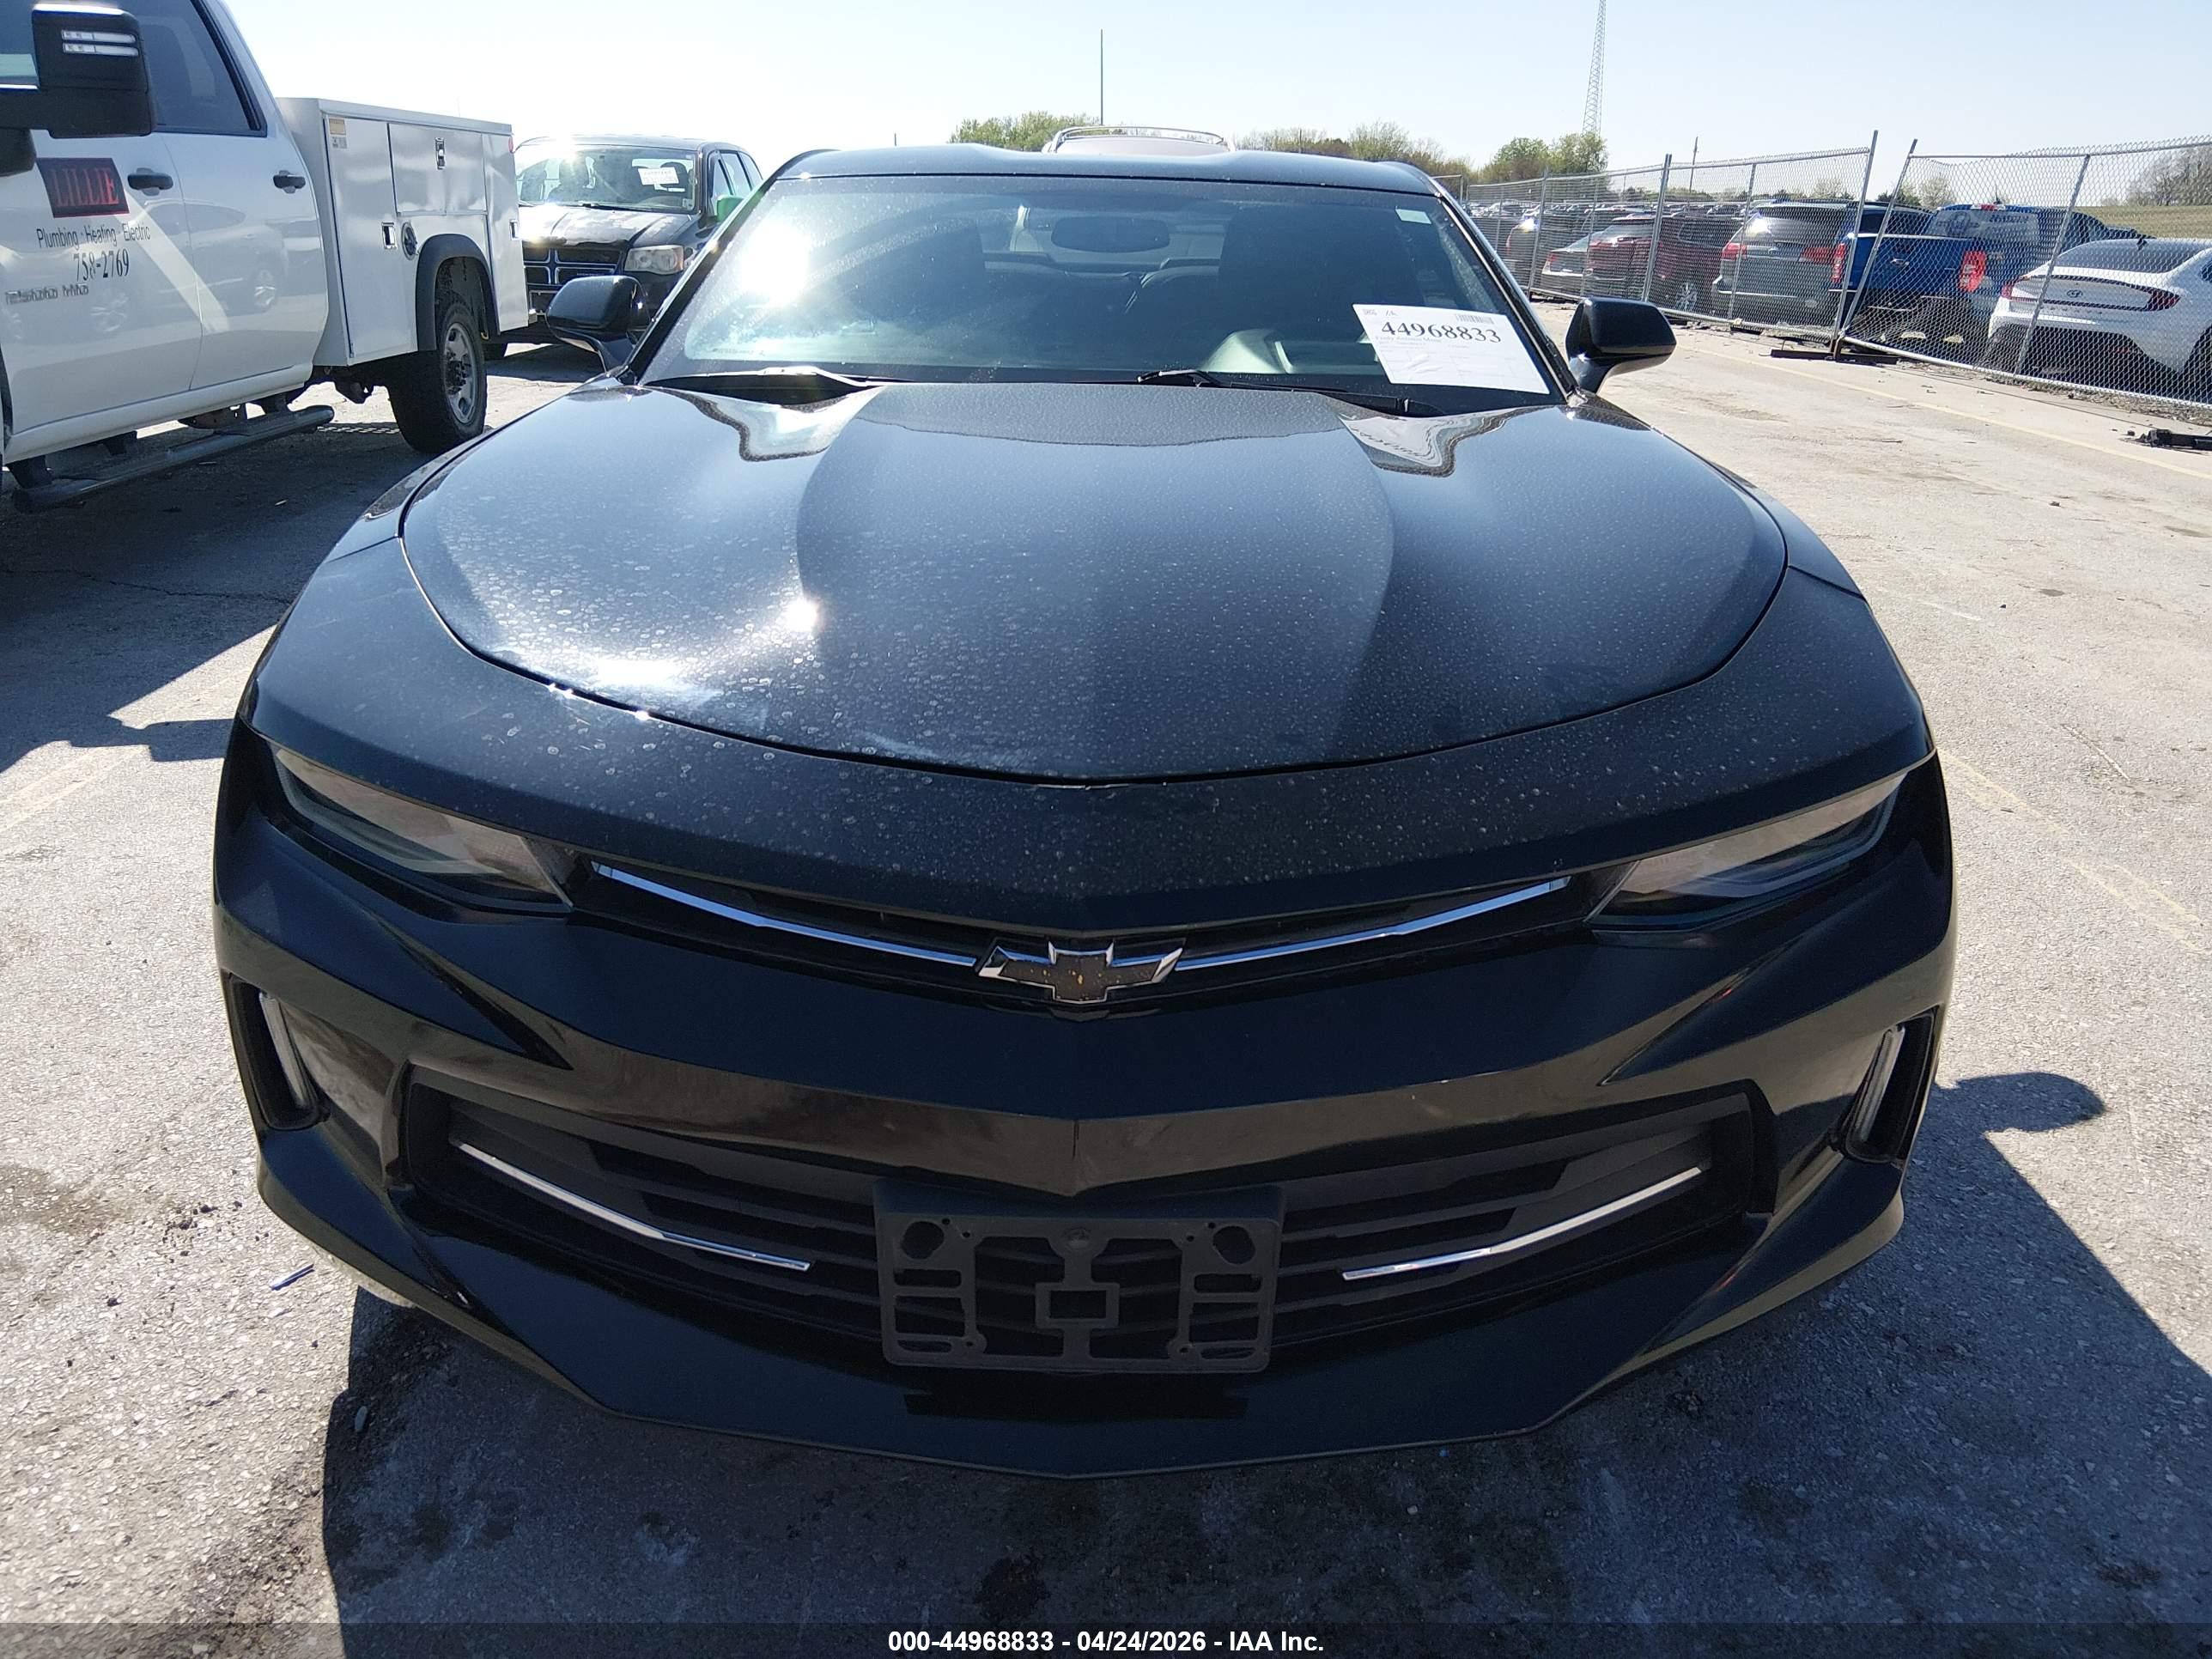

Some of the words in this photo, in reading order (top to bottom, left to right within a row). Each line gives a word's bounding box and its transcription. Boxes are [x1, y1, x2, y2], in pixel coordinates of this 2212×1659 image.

[49, 167, 120, 208] LILLIE
[36, 227, 80, 251] Plumbing
[83, 224, 118, 247] Heating
[122, 222, 151, 241] Electric
[73, 248, 130, 282] 758-2769
[1381, 321, 1502, 343] 44968833
